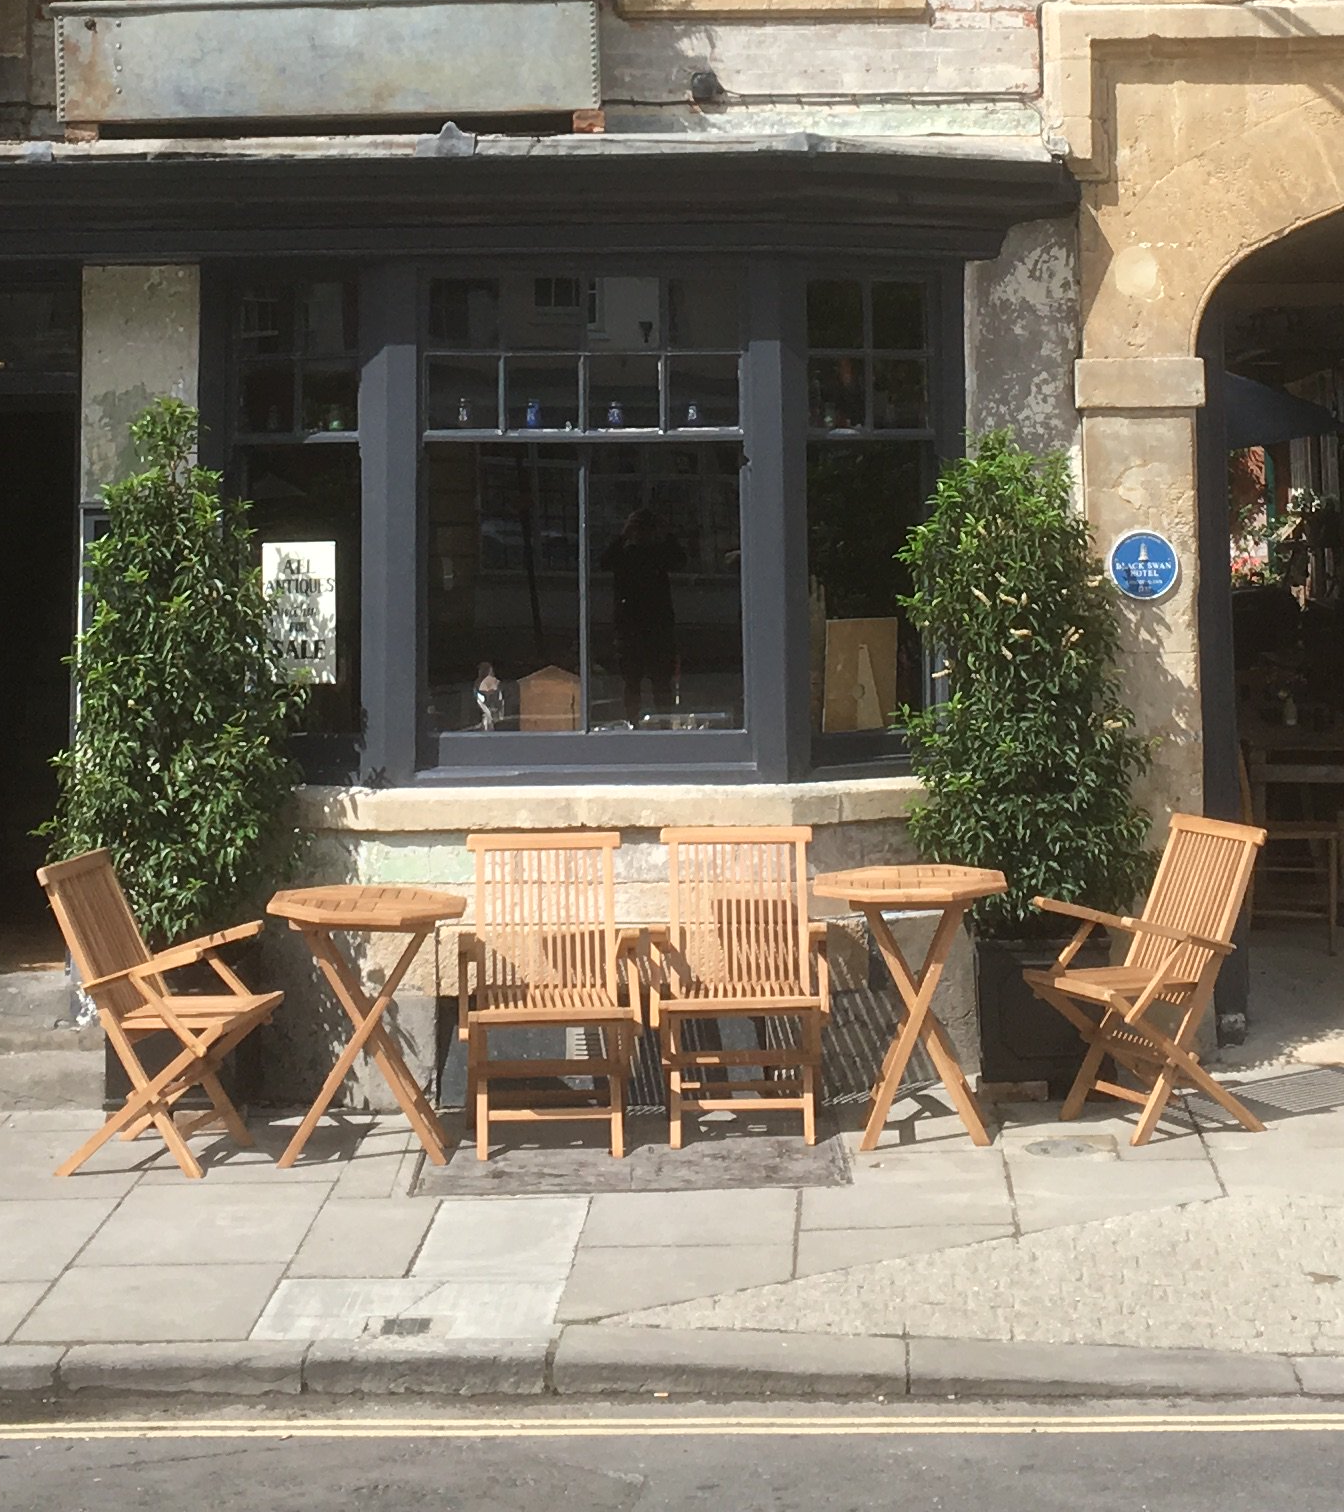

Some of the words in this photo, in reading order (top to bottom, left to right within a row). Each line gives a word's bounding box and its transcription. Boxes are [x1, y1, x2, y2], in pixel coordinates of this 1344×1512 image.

[284, 559, 317, 575] ALL
[1116, 561, 1145, 570] BLACK
[1147, 561, 1172, 570] SWAN
[264, 578, 335, 596] ANTIQUES
[272, 639, 326, 660] SALE
